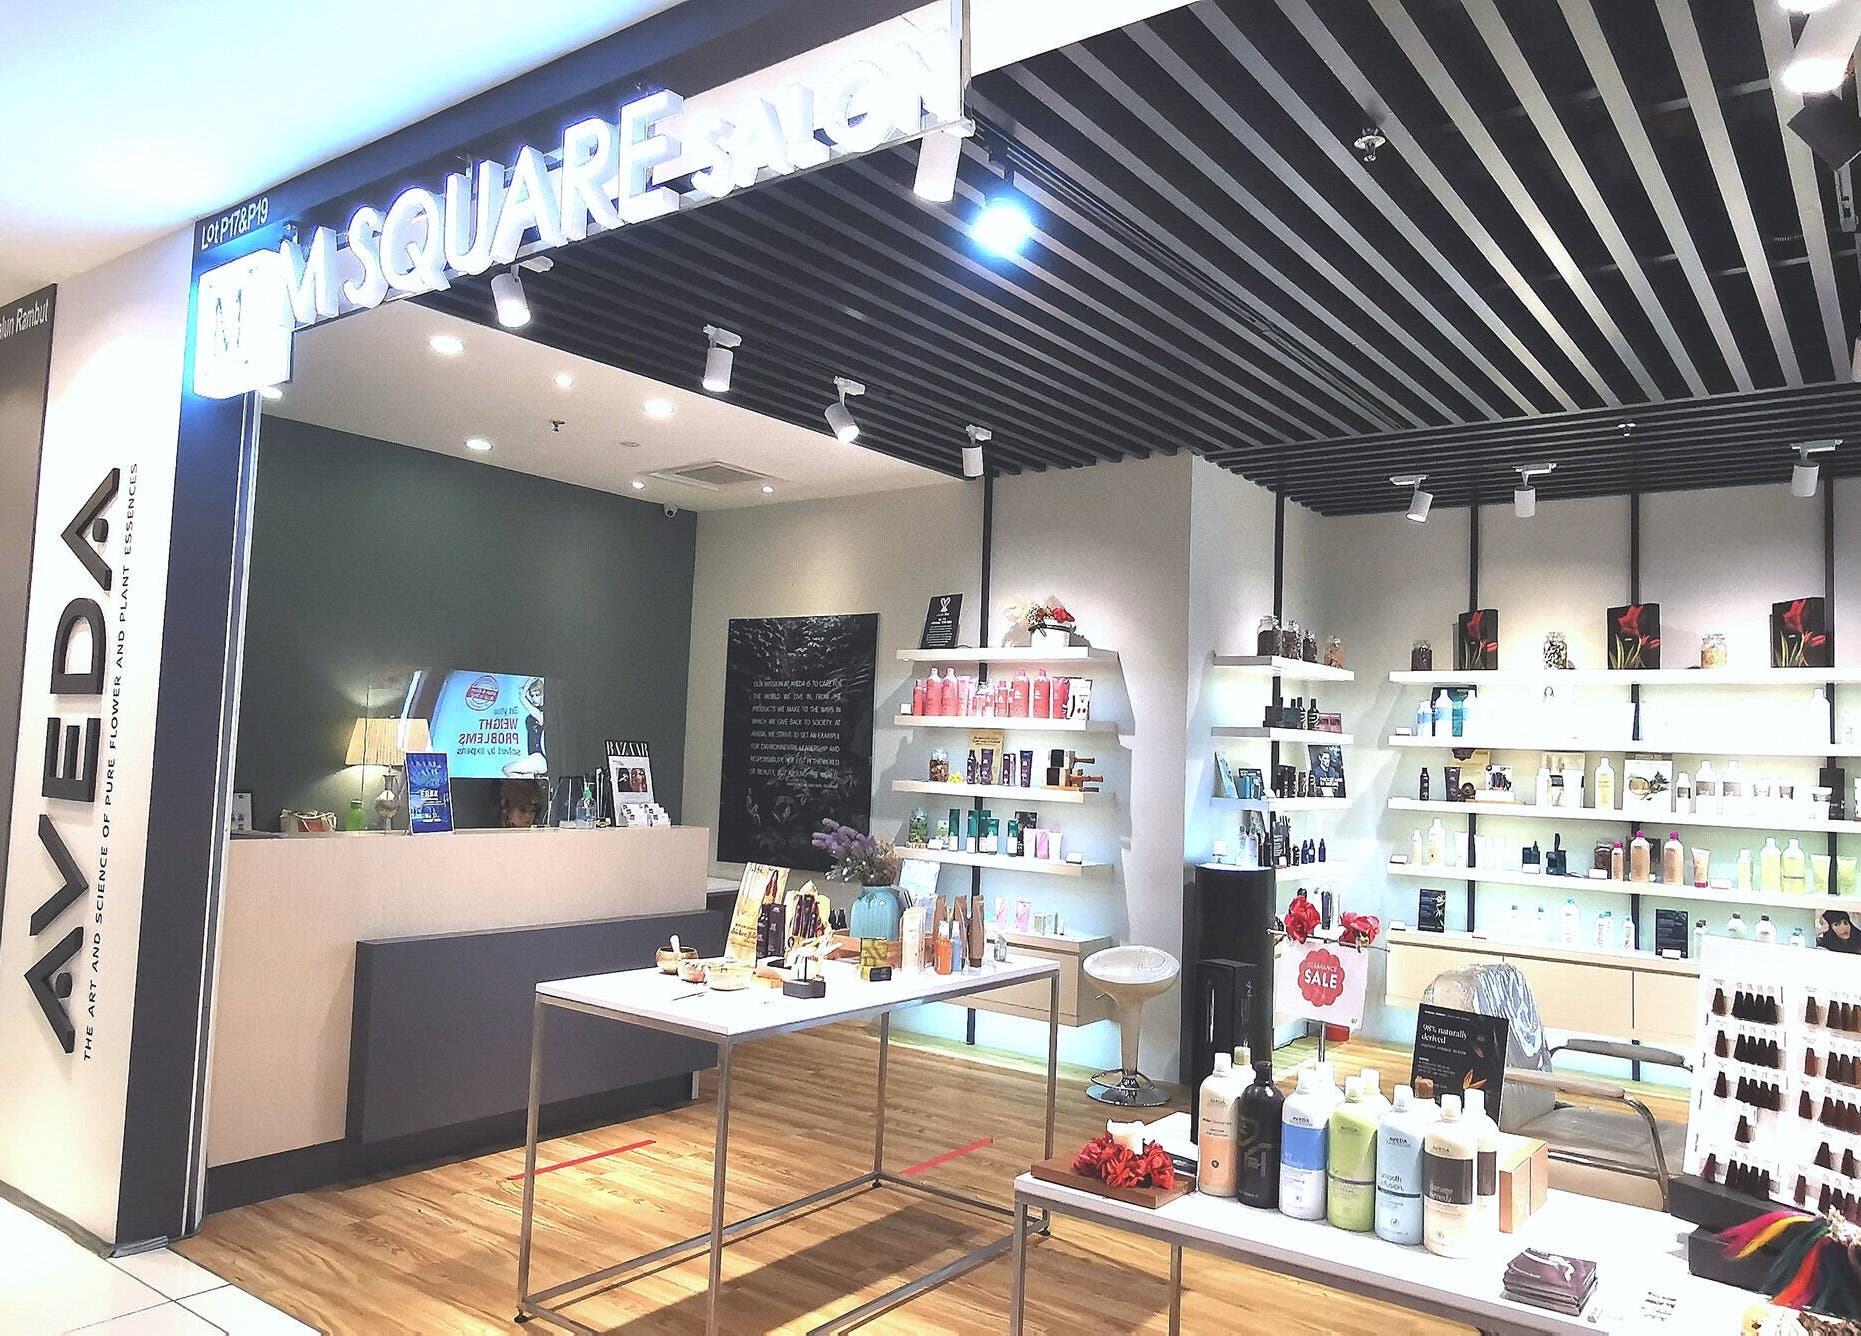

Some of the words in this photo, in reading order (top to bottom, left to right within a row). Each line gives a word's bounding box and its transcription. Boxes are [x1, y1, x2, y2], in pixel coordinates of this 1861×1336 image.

[279, 225, 341, 328] M
[343, 88, 686, 308] SQUARE
[690, 27, 957, 198] SALON
[15, 298, 49, 334] Rambut
[124, 462, 139, 556] ESSENCES
[118, 564, 131, 622] PLANT
[114, 630, 126, 669] AND
[109, 674, 122, 749] FLOWER
[24, 467, 121, 1054] AVEDA
[105, 757, 116, 806] PURE
[102, 811, 111, 839] OF
[95, 845, 109, 925] SCIENCE
[91, 932, 102, 973] AND
[87, 979, 98, 1018] ART
[1304, 968, 1339, 989] SALE
[83, 1025, 95, 1062] THE
[1421, 1032, 1447, 1045] derived
[1437, 1027, 1468, 1041] naturally
